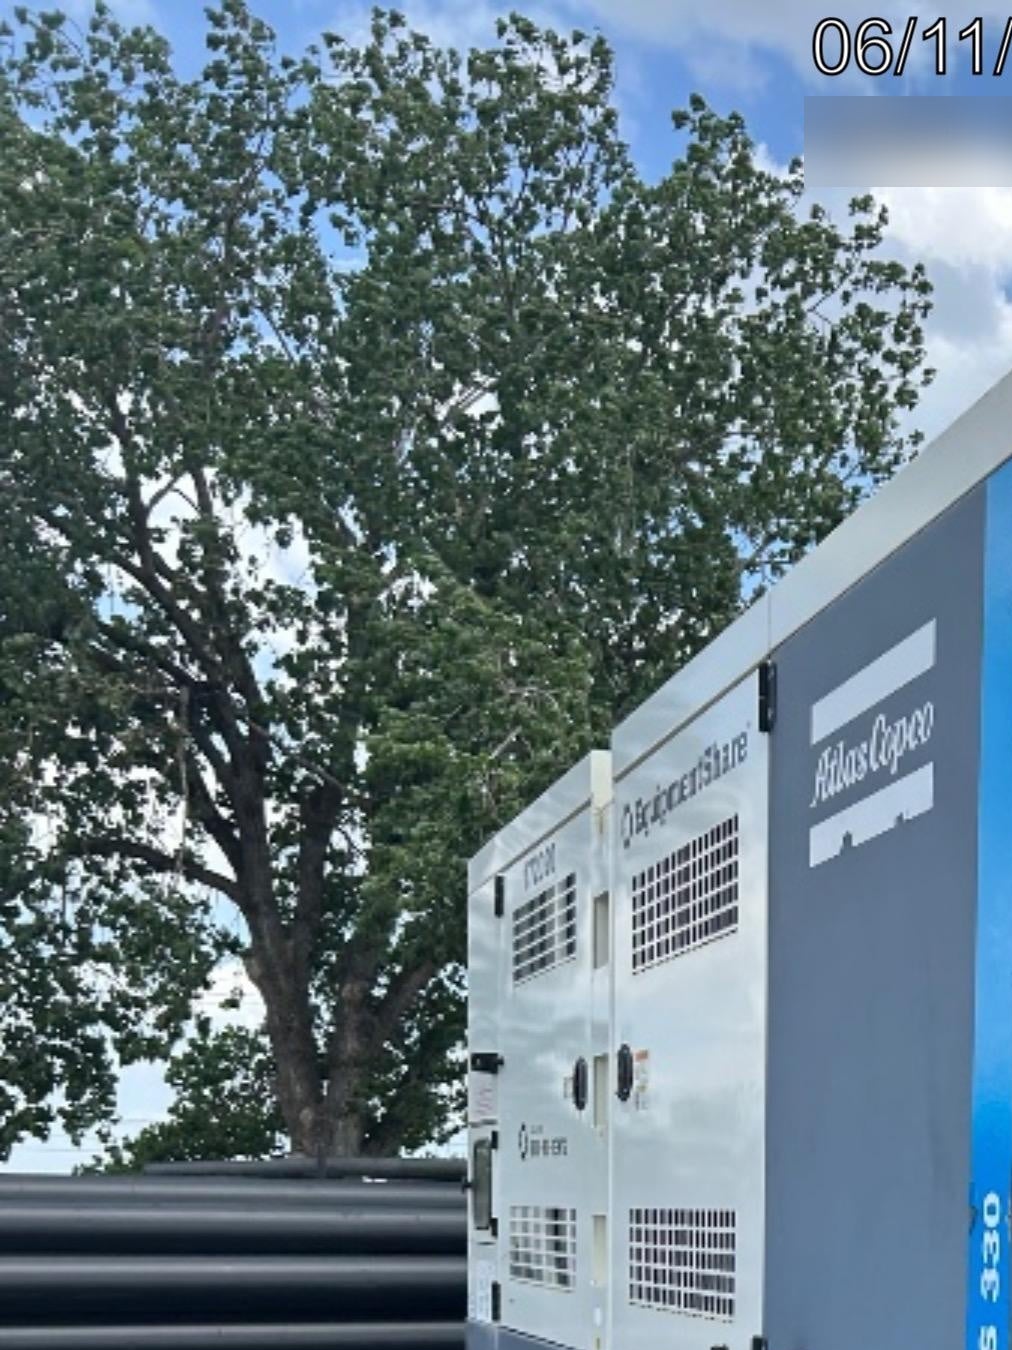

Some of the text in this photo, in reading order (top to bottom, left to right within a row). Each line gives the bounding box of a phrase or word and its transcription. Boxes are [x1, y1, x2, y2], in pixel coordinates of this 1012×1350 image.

[809, 701, 934, 808] Atlas Copco
[979, 1191, 1001, 1303] 330
